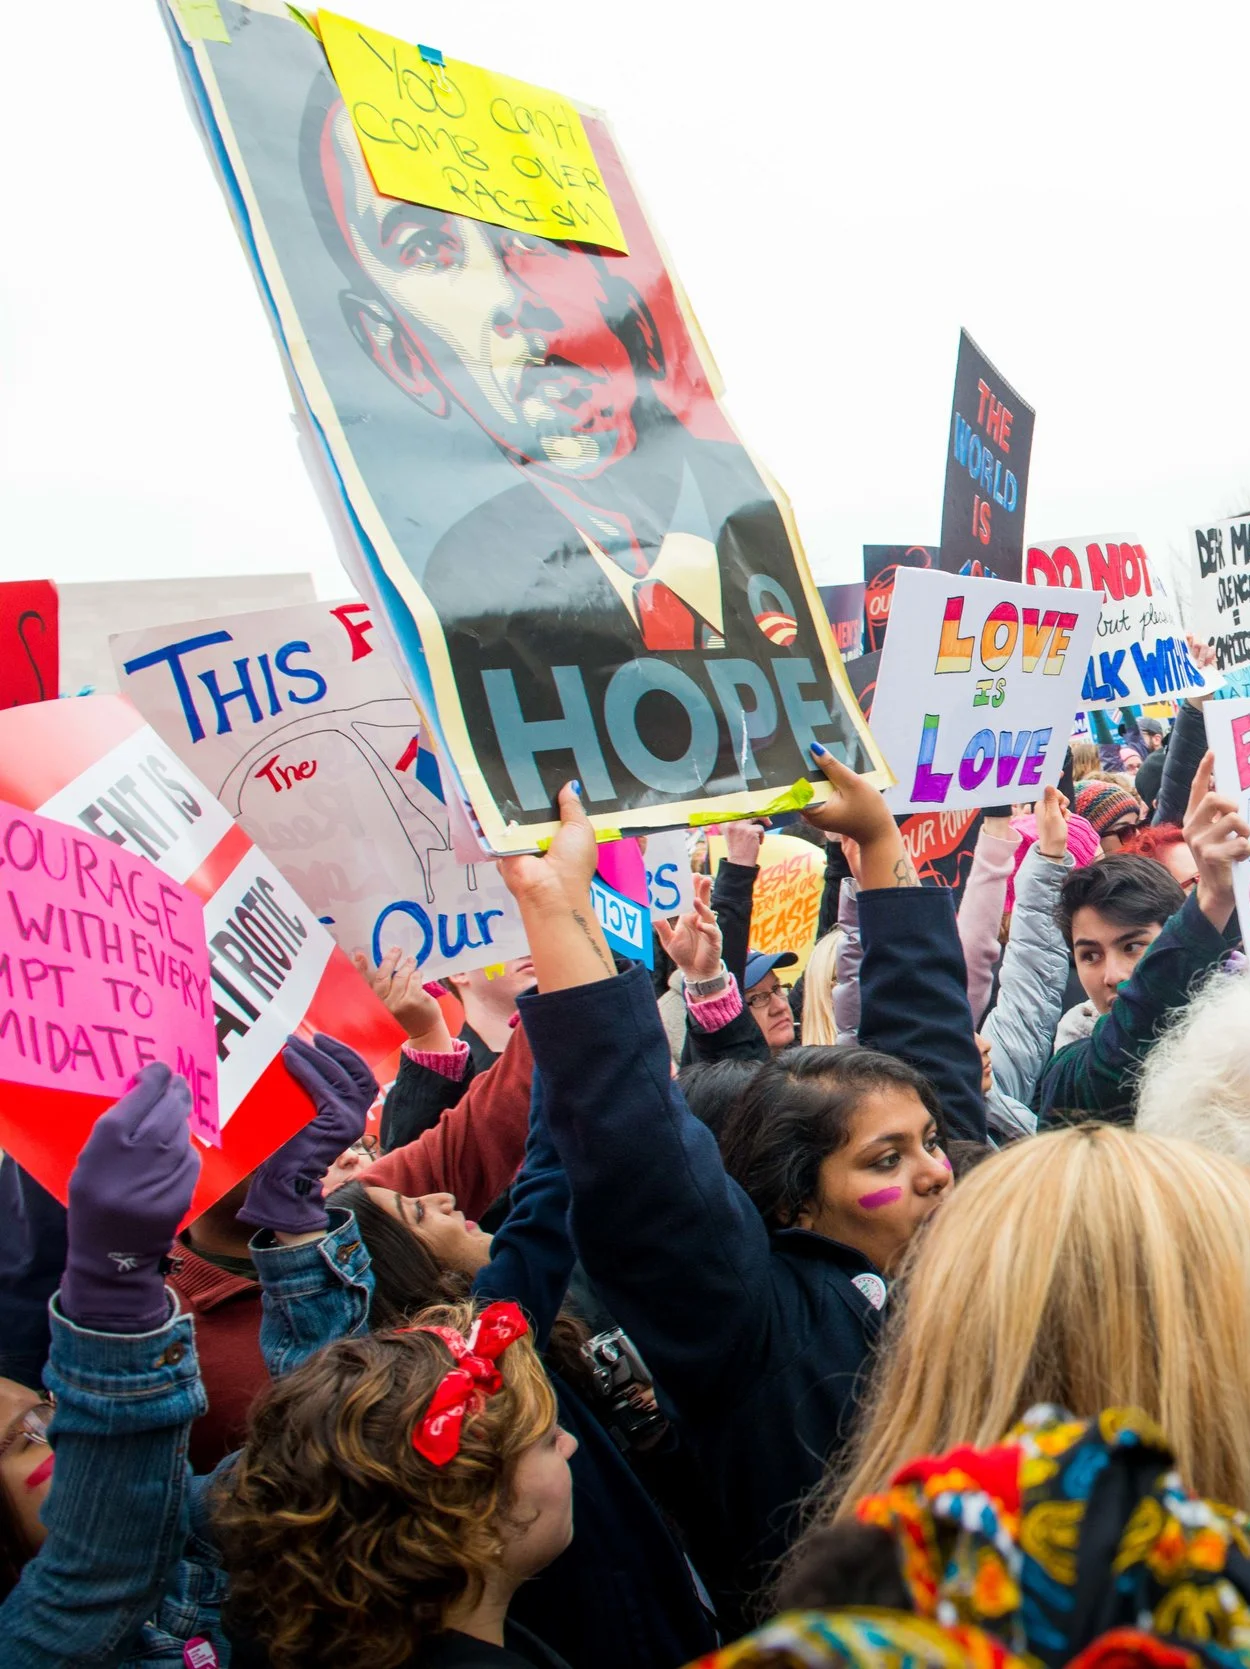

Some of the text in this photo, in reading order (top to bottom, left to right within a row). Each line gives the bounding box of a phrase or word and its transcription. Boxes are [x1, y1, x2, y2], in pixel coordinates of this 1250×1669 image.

[353, 102, 607, 196] COMB OVER
[978, 378, 1015, 454] THE
[954, 411, 1018, 513] WORLD
[972, 494, 992, 545] IS
[1026, 545, 1082, 589] DO
[1086, 542, 1153, 604] NOT
[934, 596, 1079, 675] LOVE
[123, 630, 329, 744] THIS
[973, 677, 1006, 708] IS
[481, 656, 848, 811] HOPE
[910, 713, 1053, 803] LOVE
[137, 754, 203, 824] IS
[254, 755, 317, 793] The
[0, 819, 194, 955] OURAGE
[753, 852, 812, 896] ESIST
[8, 890, 209, 1020] WITH EVERY
[211, 876, 308, 1062] ATRIOTIC
[372, 900, 504, 974] Our
[103, 977, 153, 1019] TO
[0, 1009, 157, 1082] MIDATE
